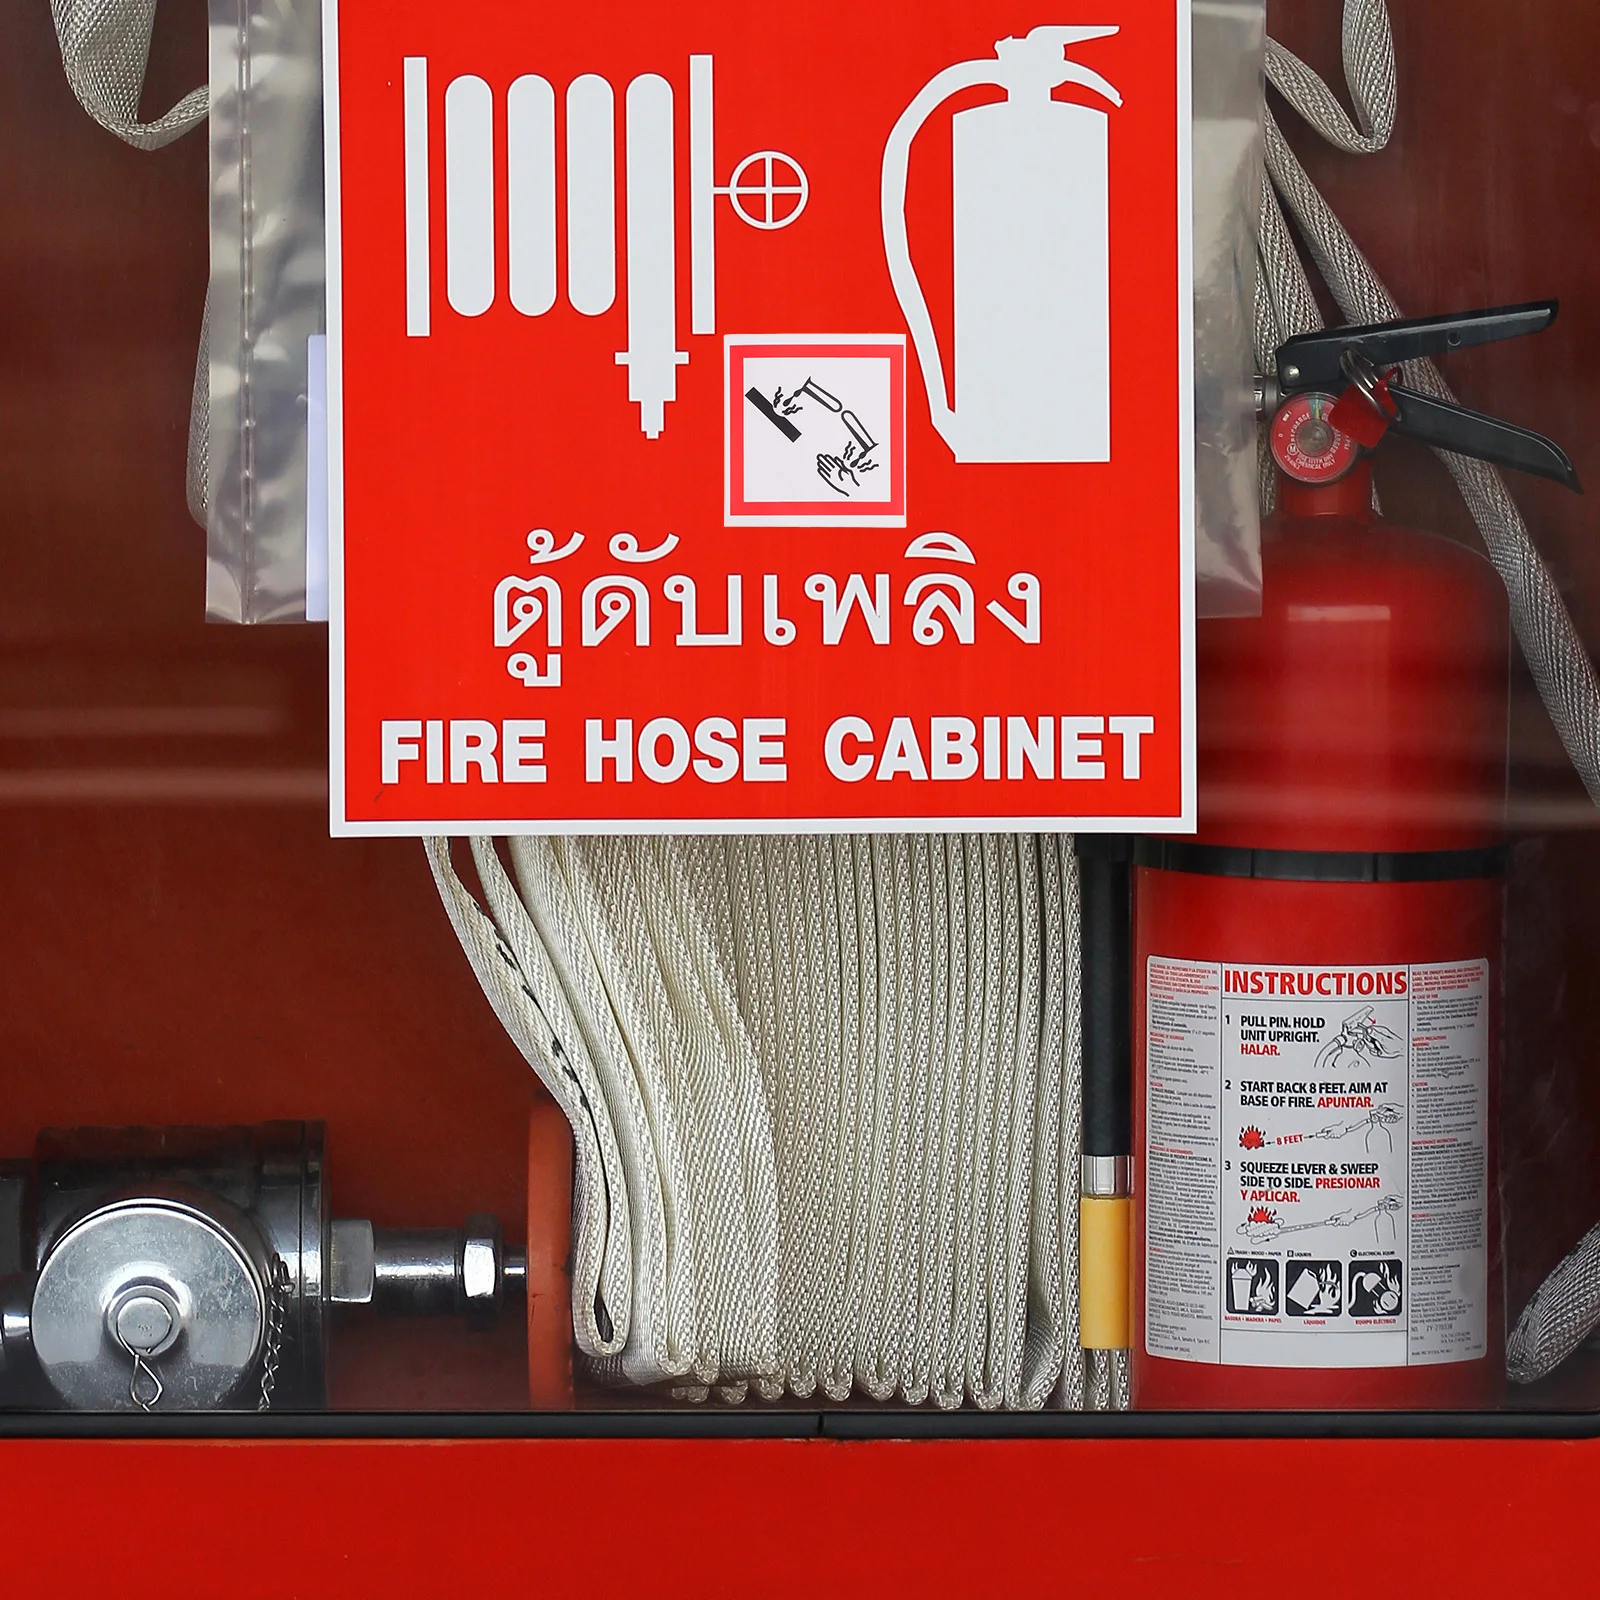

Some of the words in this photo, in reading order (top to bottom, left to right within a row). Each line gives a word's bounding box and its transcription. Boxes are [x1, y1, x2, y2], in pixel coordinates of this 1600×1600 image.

[1290, 413, 1311, 442] RECHARGE
[1296, 458, 1322, 469] CHEMICAL
[1323, 459, 1336, 469] ONLY
[493, 529, 1042, 688] ตู้ดับเพลิง
[381, 719, 547, 784] FIRE
[585, 716, 788, 784] HOSE
[824, 715, 1155, 782] CABINET
[1224, 970, 1407, 995] INSTRUCTIONS
[1225, 1015, 1230, 1024] 1
[1240, 1015, 1267, 1027] PULL
[1269, 1016, 1291, 1028] PIN.
[1293, 1017, 1325, 1029] HOLD
[1240, 1030, 1266, 1041] UNIT
[1268, 1031, 1319, 1043] UPRIGHT.
[1240, 1044, 1280, 1056] HALAR.
[1225, 1080, 1231, 1090] 2
[1240, 1081, 1274, 1093] START
[1276, 1081, 1307, 1093] BACK
[1309, 1082, 1316, 1094] 8
[1319, 1082, 1347, 1094] FEET.
[1350, 1082, 1371, 1093] AIM
[1373, 1082, 1388, 1093] AT
[1240, 1095, 1268, 1106] BASE
[1271, 1096, 1286, 1107] OF
[1288, 1096, 1315, 1107] FIRE.
[1317, 1096, 1374, 1108] APUNTAR.
[1277, 1137, 1282, 1145] 8
[1284, 1134, 1303, 1144] FEET
[1224, 1161, 1231, 1170] 3
[1240, 1162, 1288, 1174] SQUEEZE
[1291, 1163, 1326, 1175] LEVER
[1328, 1163, 1338, 1174] &
[1341, 1163, 1378, 1175] SWEEP
[1240, 1176, 1264, 1188] SIDE
[1267, 1177, 1282, 1188] TO
[1284, 1177, 1313, 1189] SIDE.
[1315, 1177, 1380, 1189] PRESIONAR
[1240, 1190, 1248, 1200] Y
[1250, 1190, 1301, 1202] APLICAR.
